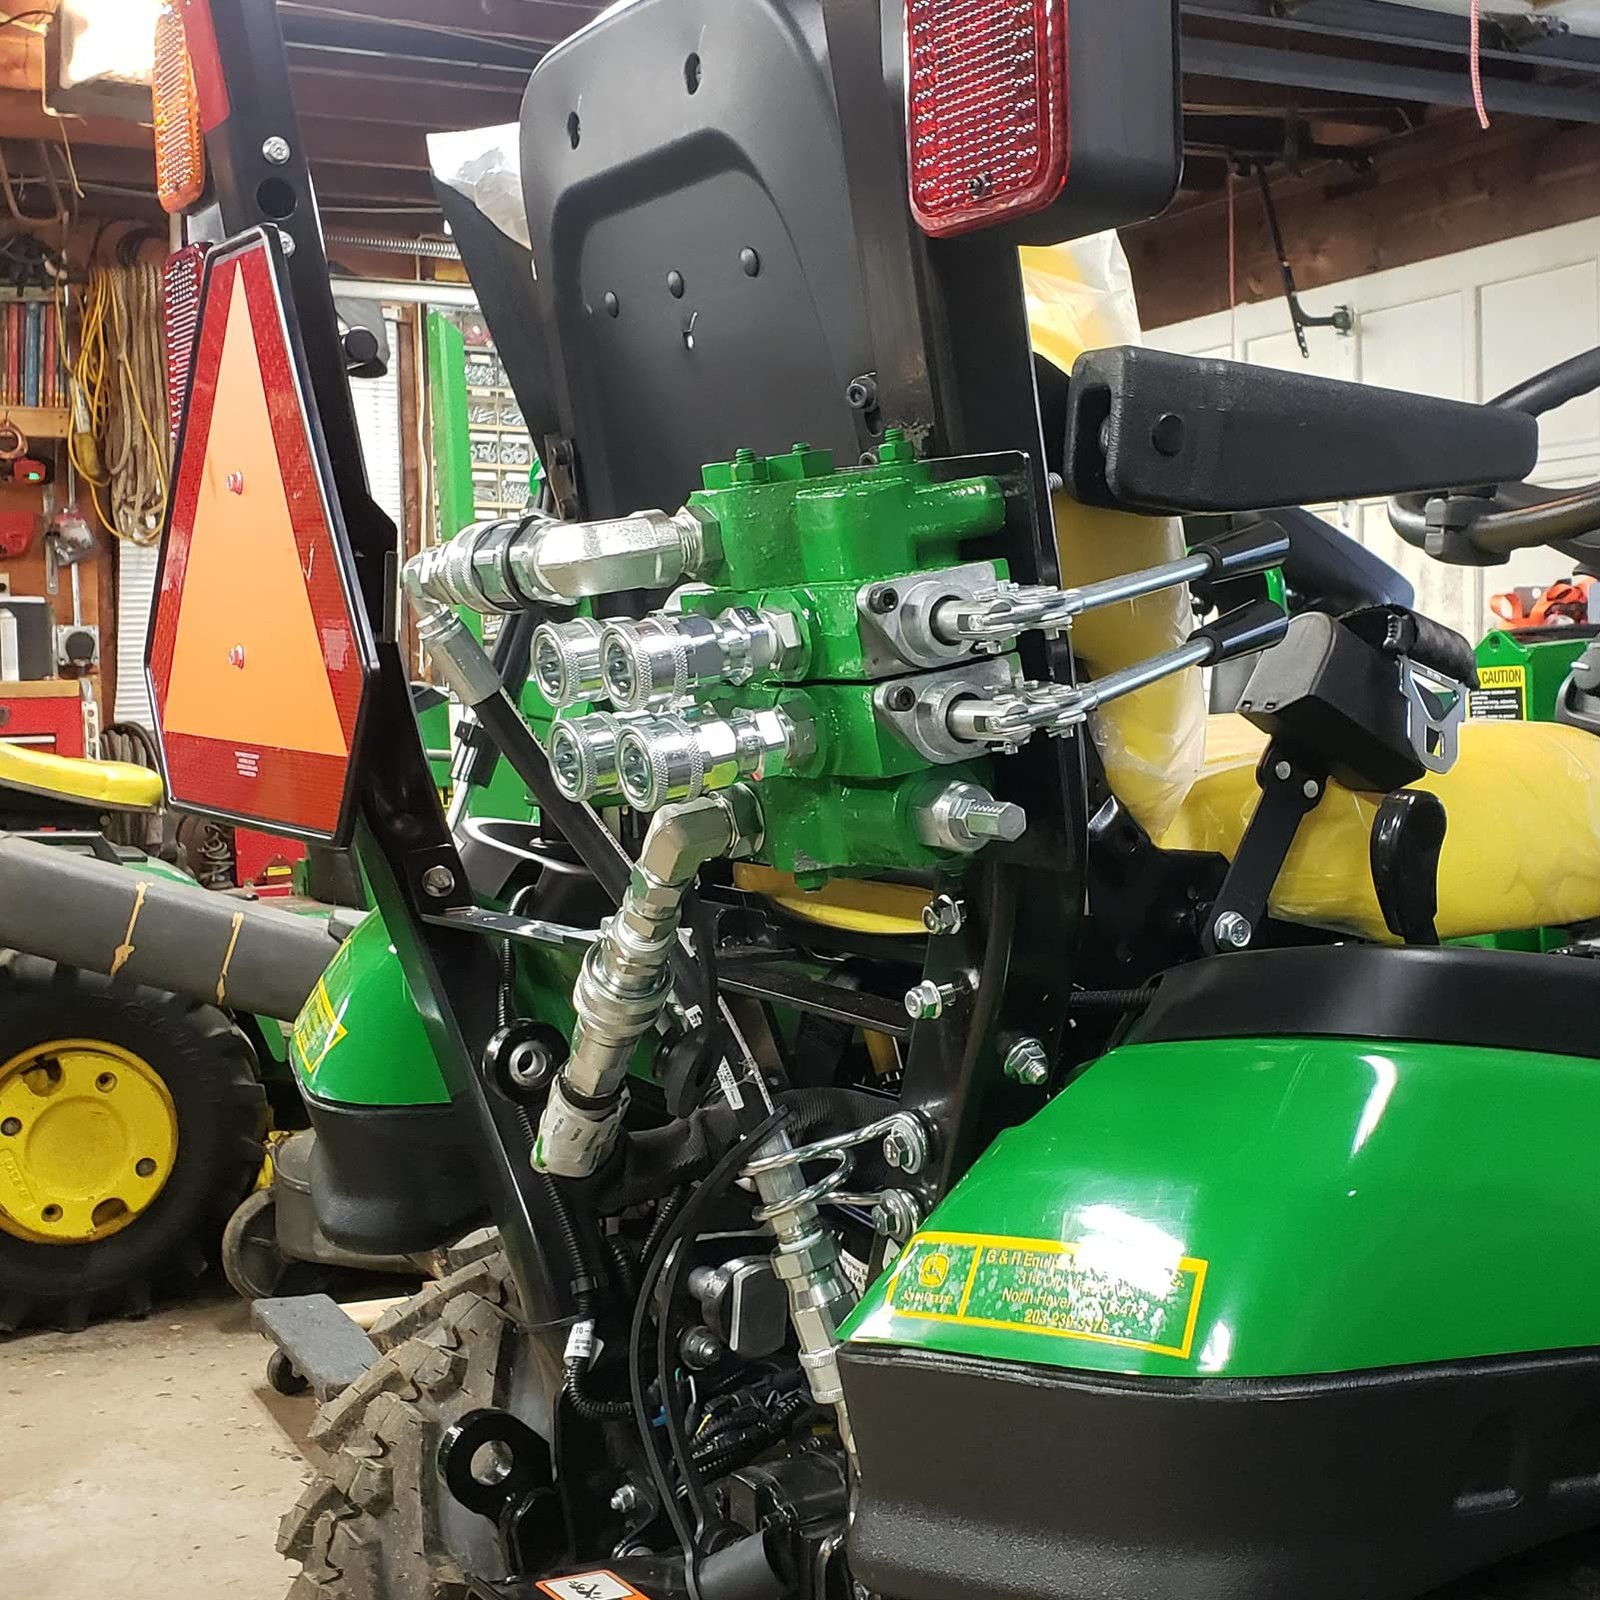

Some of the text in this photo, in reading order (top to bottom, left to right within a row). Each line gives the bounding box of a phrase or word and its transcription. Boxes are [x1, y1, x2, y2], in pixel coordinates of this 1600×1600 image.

[1482, 669, 1521, 684] CAUTION
[986, 1249, 997, 1264] G
[999, 1250, 1008, 1265] &
[1002, 1286, 1034, 1304] North
